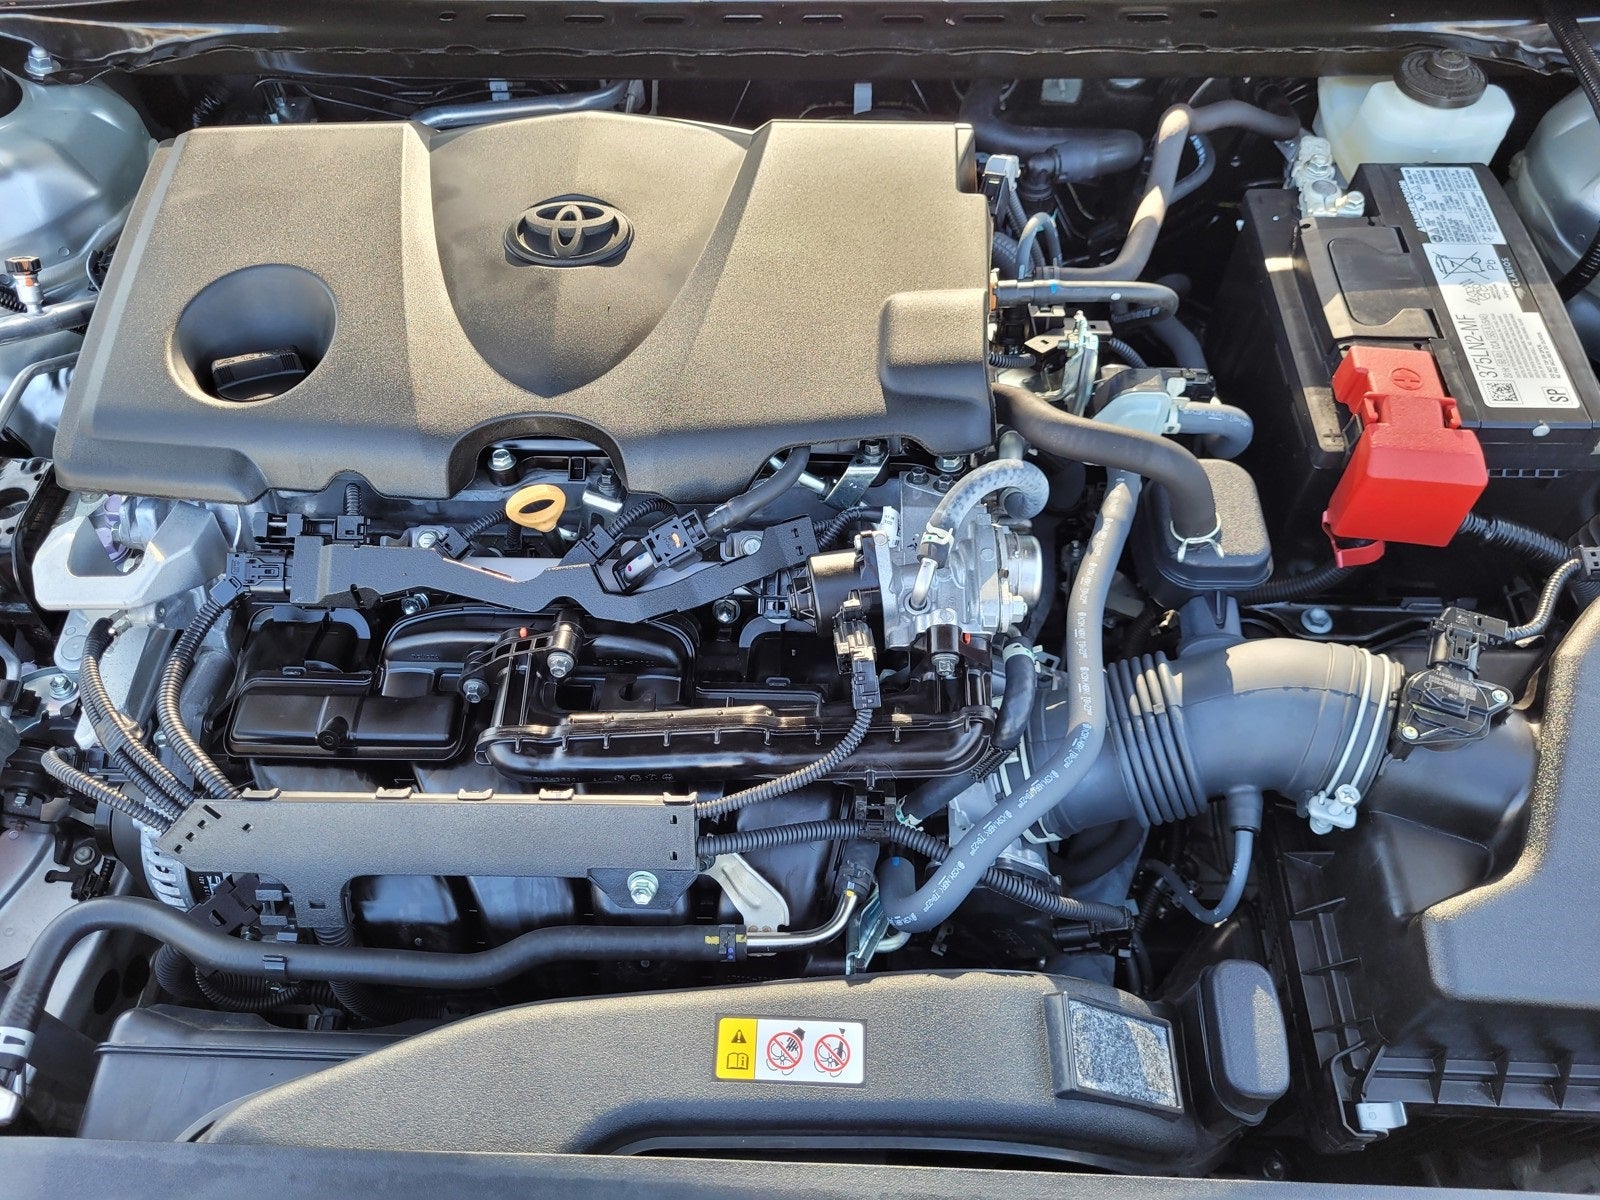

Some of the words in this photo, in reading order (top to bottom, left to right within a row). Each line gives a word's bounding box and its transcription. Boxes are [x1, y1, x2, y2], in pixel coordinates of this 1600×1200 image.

[1500, 257, 1520, 288] CLARIOS
[1455, 314, 1498, 378] 375LN2-MF
[1547, 388, 1569, 403] SP
